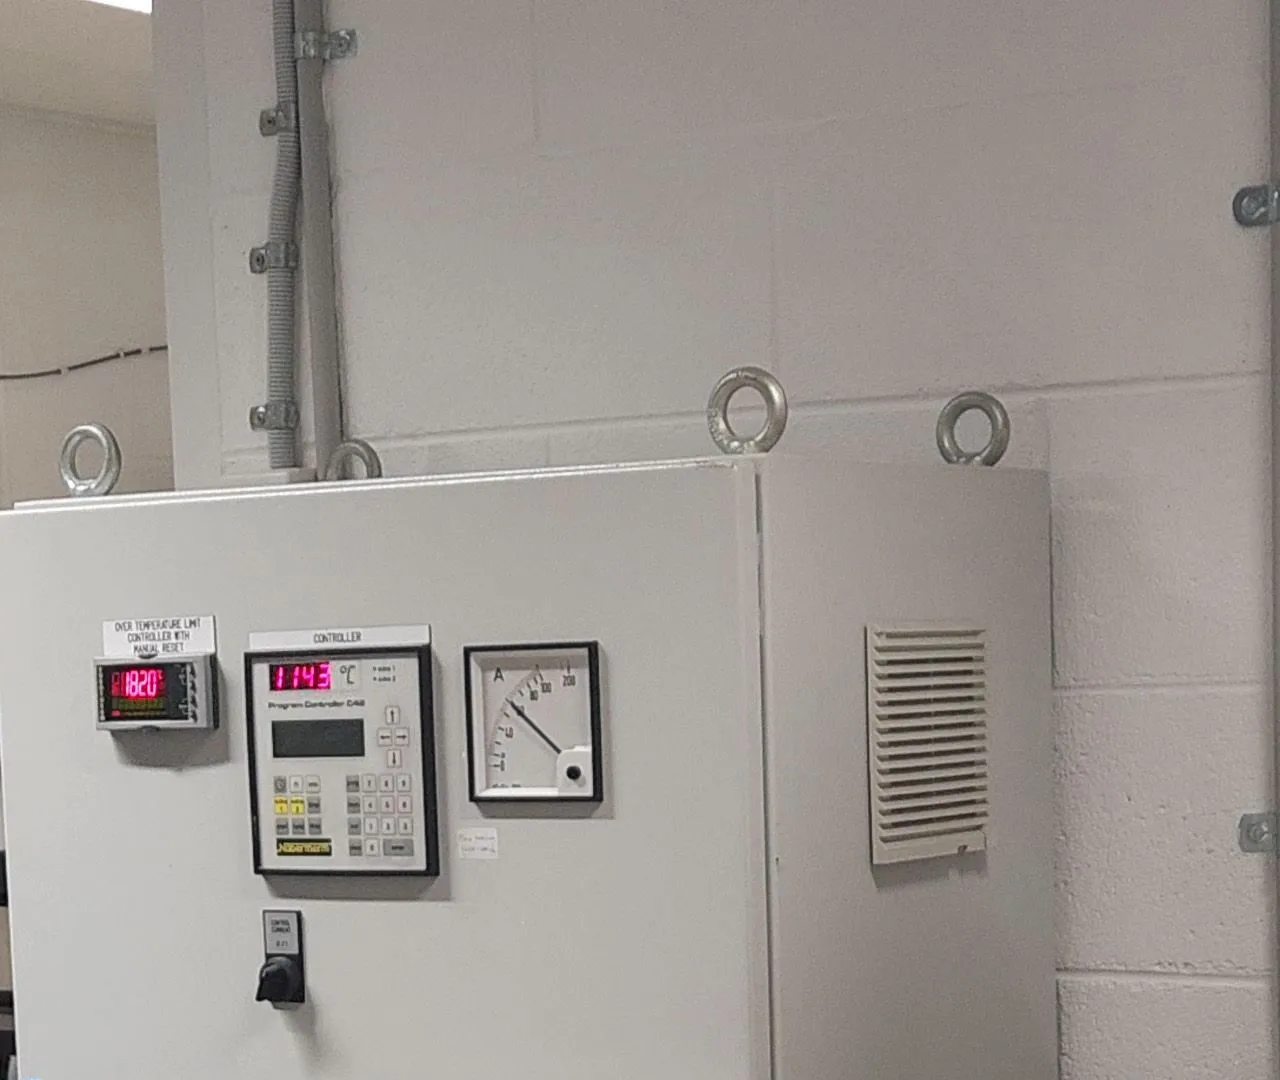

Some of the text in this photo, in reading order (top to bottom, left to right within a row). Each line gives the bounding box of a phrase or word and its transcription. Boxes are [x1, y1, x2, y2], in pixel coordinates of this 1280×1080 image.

[115, 617, 201, 632] OVER TEMPERATURE LIMIT
[127, 631, 172, 643] CONTROLLER
[313, 632, 362, 643] CONTROLLER
[133, 642, 184, 654] MANUAL RESET
[493, 667, 504, 682] A
[267, 701, 304, 710] Program
